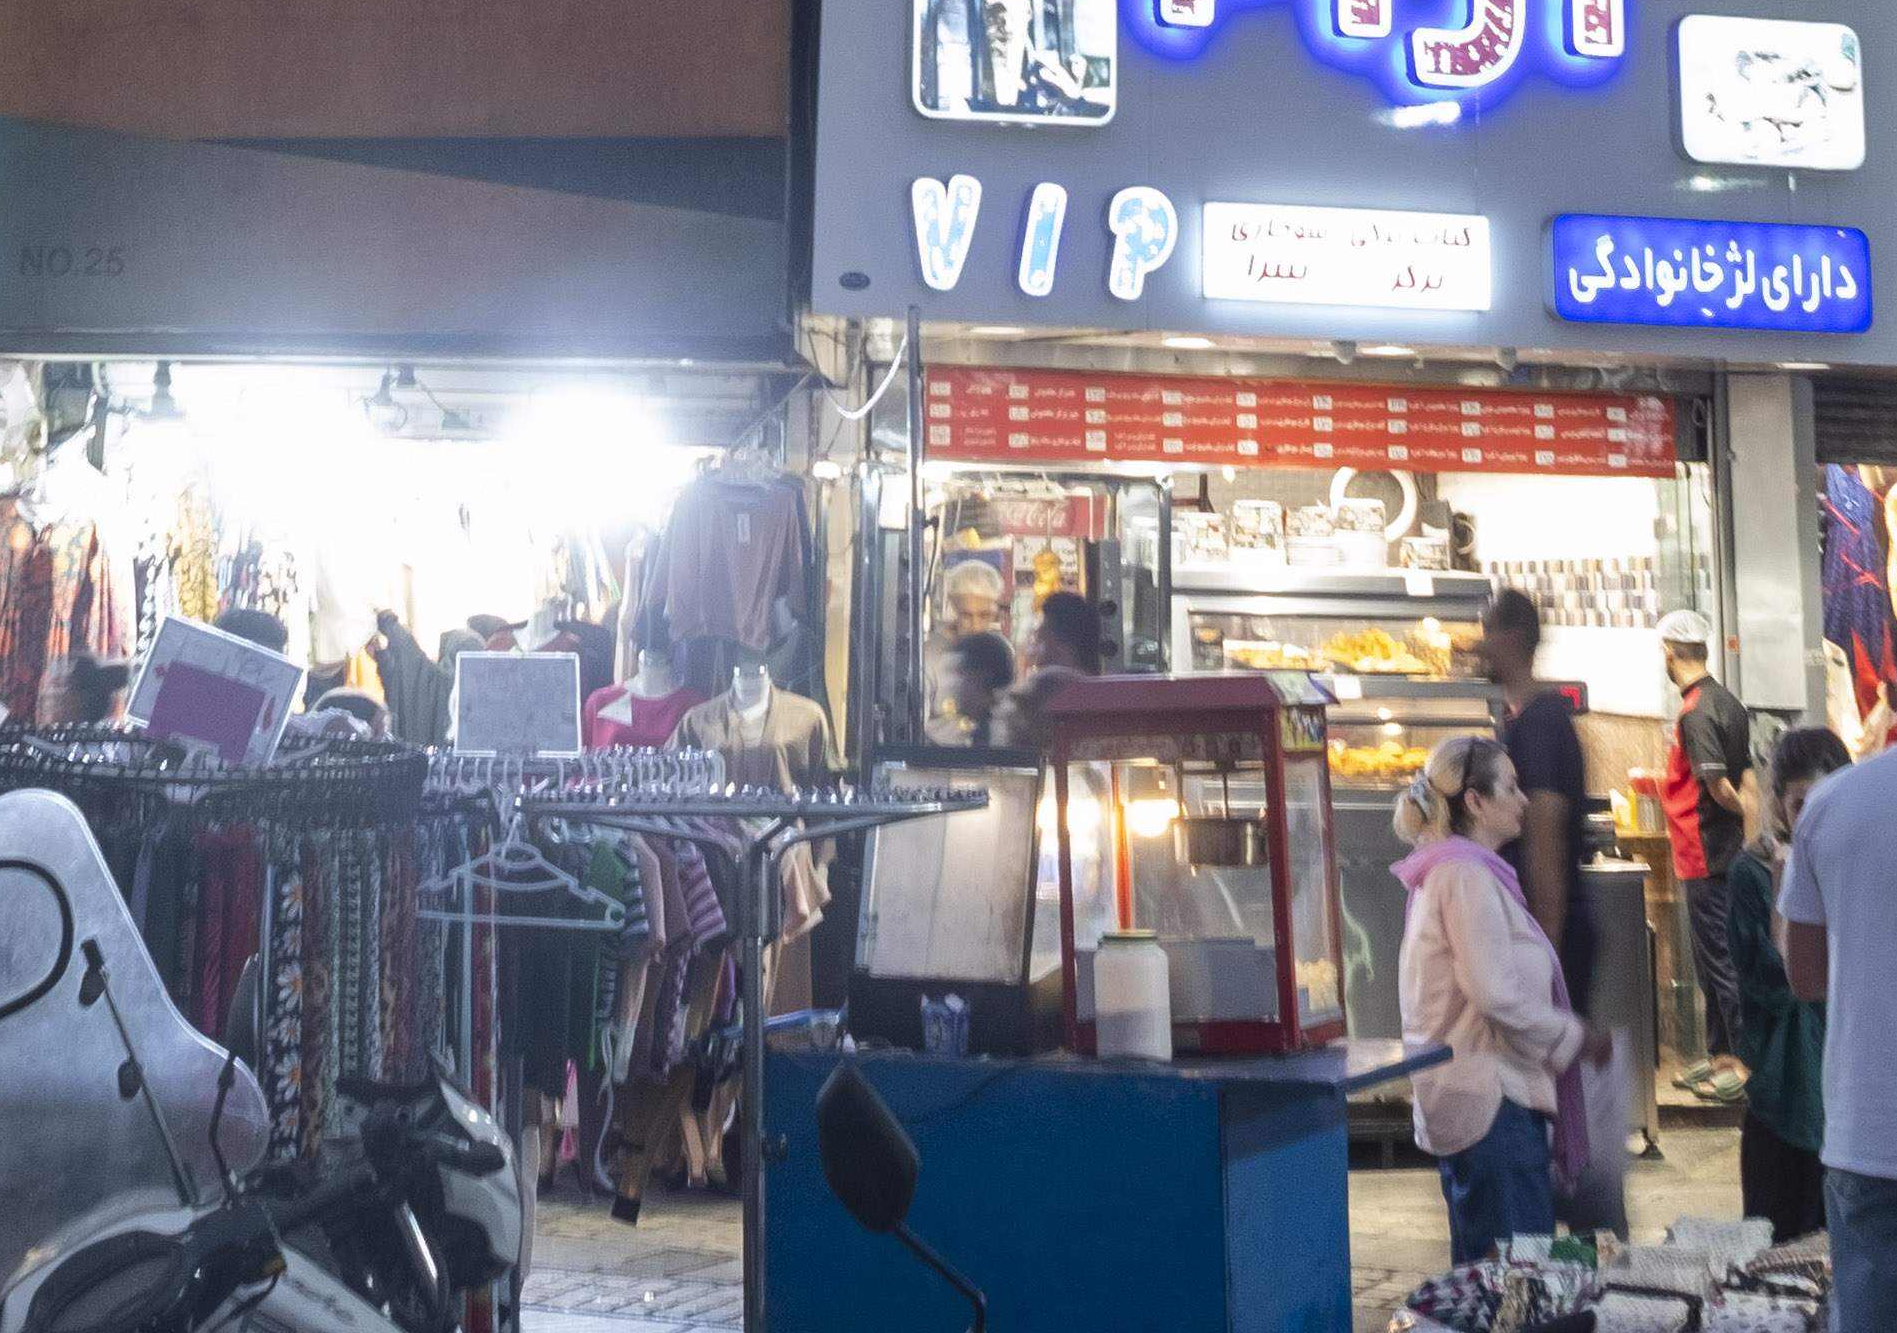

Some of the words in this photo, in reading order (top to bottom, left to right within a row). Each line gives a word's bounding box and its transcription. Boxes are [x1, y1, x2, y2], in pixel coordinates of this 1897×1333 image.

[1567, 233, 1725, 309] خانوادگی
[1725, 239, 1757, 310] لژ
[1760, 253, 1860, 314] دارای
